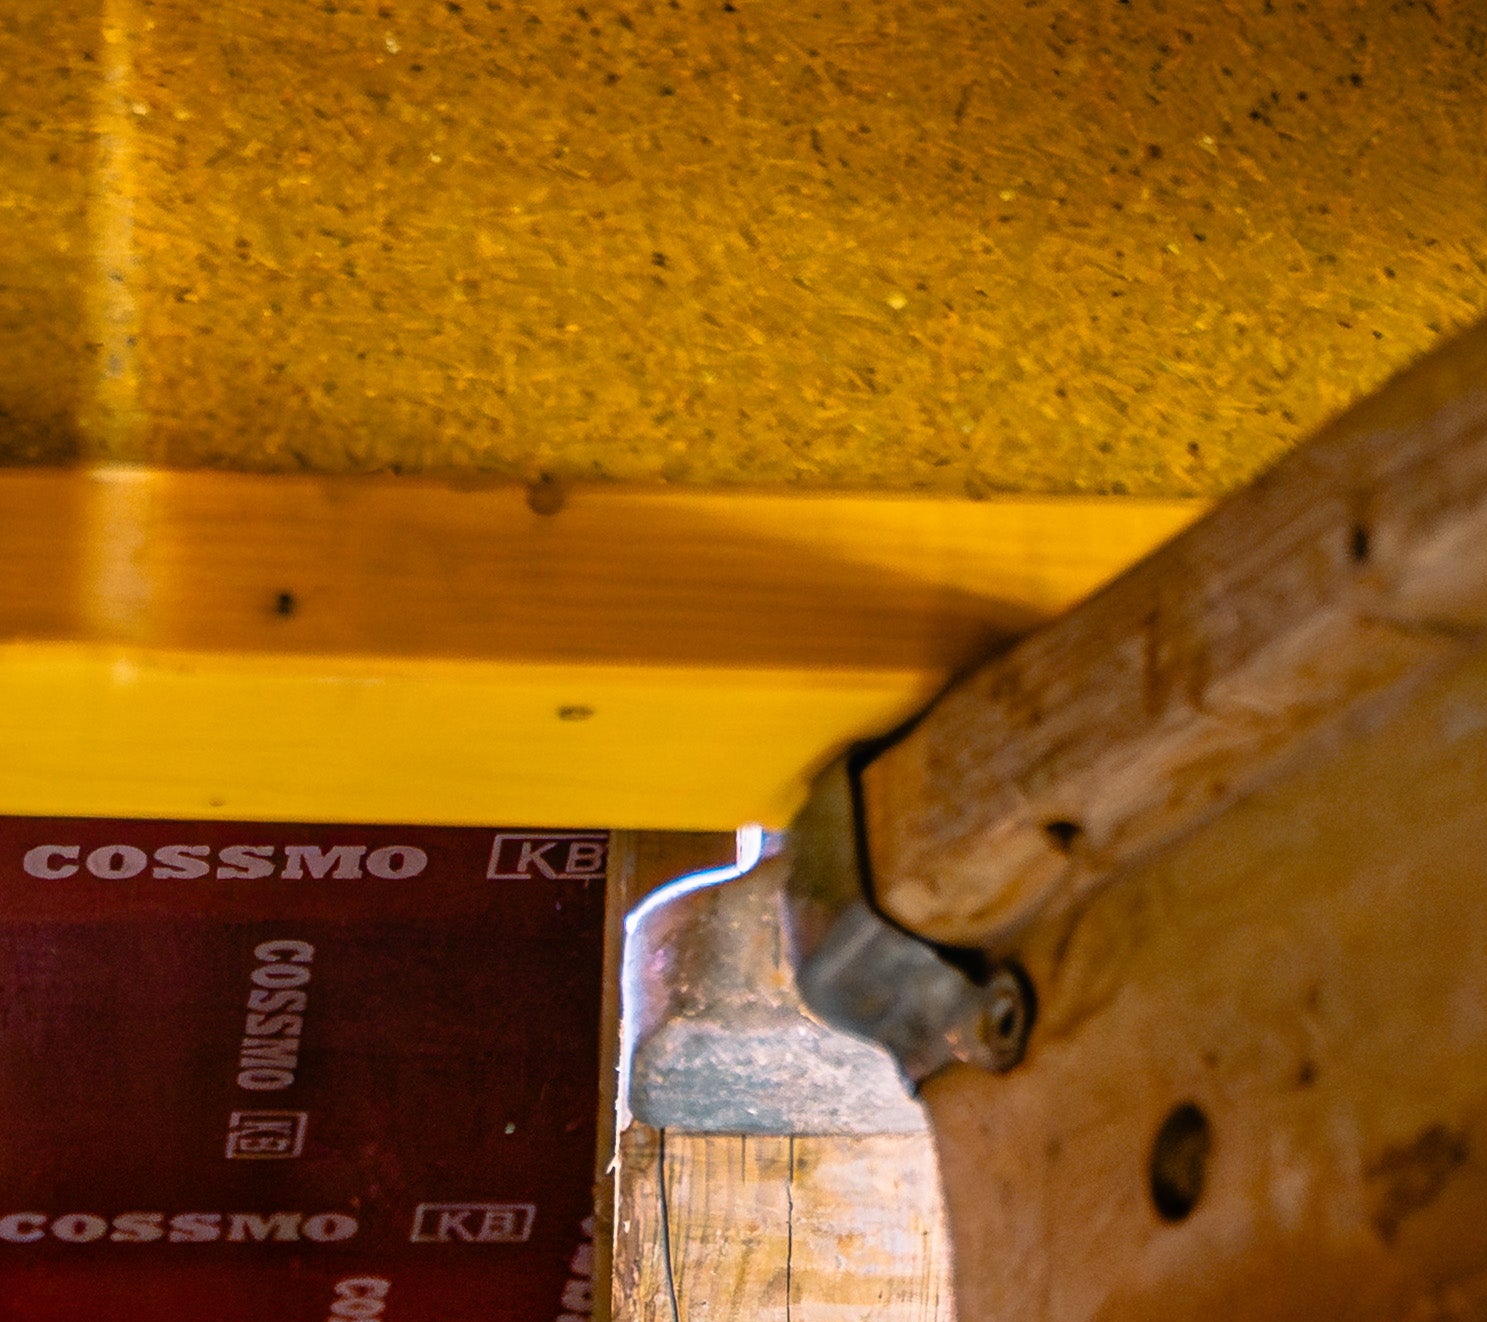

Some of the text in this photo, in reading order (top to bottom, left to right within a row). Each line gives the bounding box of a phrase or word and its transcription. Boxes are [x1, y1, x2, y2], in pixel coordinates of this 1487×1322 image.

[22, 843, 429, 881] COSSMO
[514, 839, 605, 880] KB
[235, 938, 315, 1091] COSSMO
[433, 1208, 521, 1242] KB
